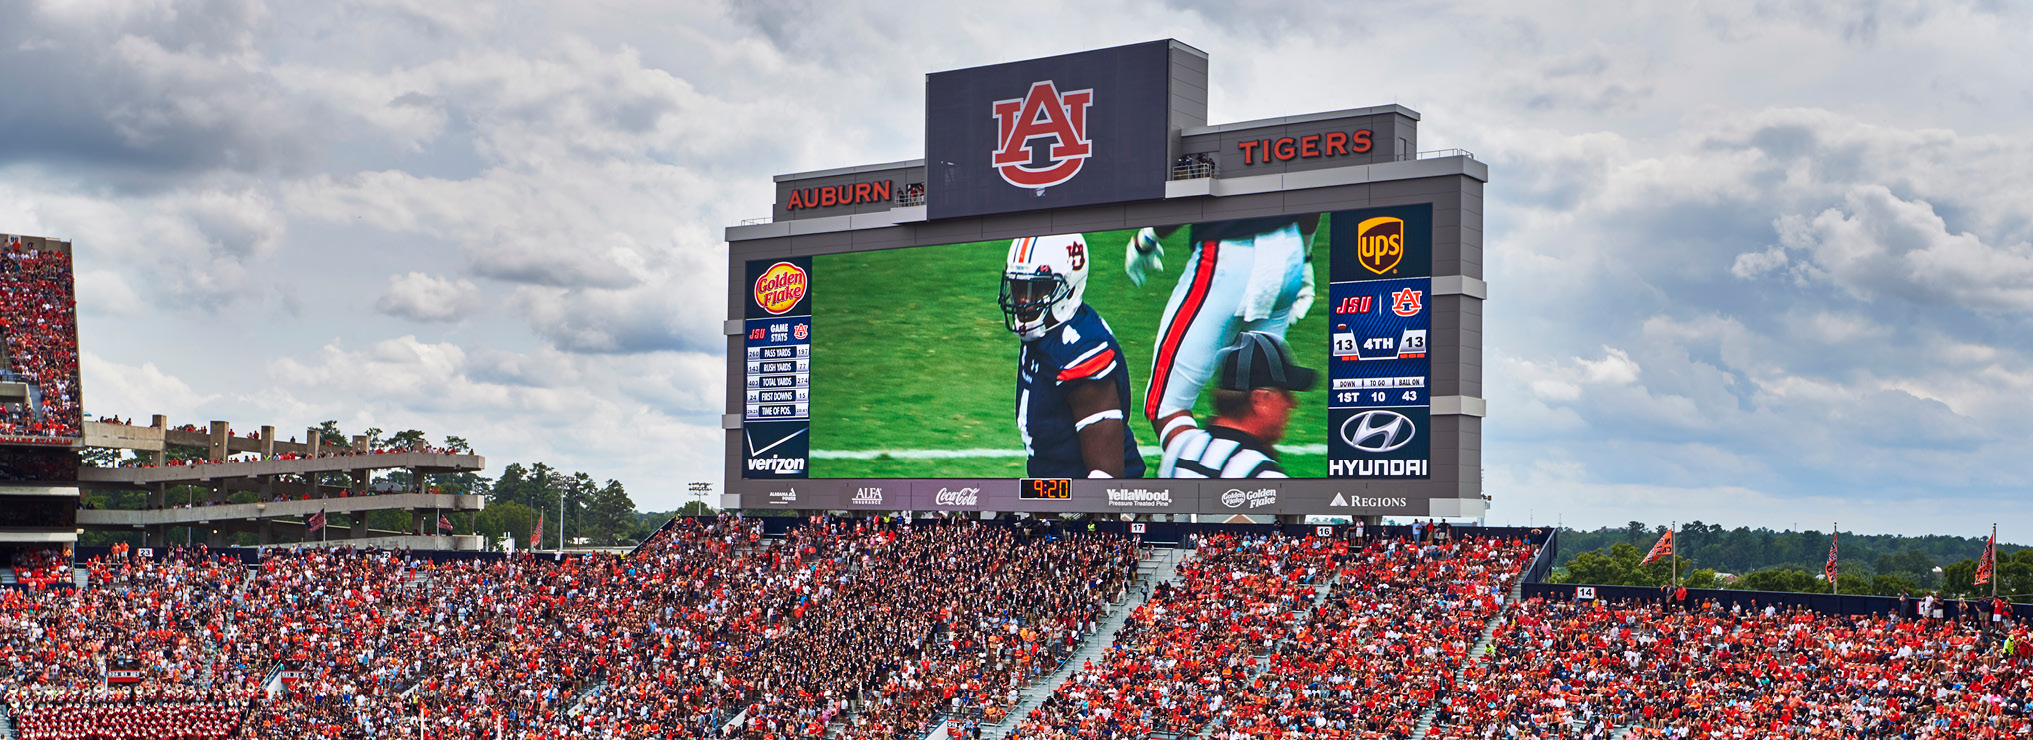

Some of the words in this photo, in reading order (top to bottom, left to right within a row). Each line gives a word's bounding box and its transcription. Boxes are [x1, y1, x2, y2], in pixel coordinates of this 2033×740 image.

[1239, 130, 1372, 164] TIGERS
[787, 181, 890, 210] AUBURN
[1361, 234, 1400, 265] ups
[758, 272, 803, 293] Golden
[764, 286, 801, 307] Flake
[1336, 296, 1372, 314] JSU
[770, 324, 788, 333] GAME
[749, 329, 765, 339] JSU
[771, 333, 788, 343] STATS
[1336, 340, 1353, 350] 13
[1363, 338, 1394, 350] 4TH
[1406, 337, 1424, 347] 13
[765, 349, 776, 358] PASS
[777, 348, 791, 357] YARDS
[776, 363, 791, 372] YARDS
[762, 378, 776, 387] TOTAL
[777, 377, 792, 386] YARDS
[762, 393, 773, 401] FIRST
[774, 392, 792, 401] DOWNS
[1337, 392, 1360, 403] 1ST
[1371, 392, 1386, 402] 10
[1402, 391, 1417, 401] 43
[773, 407, 780, 415] OF
[748, 454, 804, 474] verizon
[1329, 459, 1427, 476] HYUNDAI
[856, 487, 882, 499] ALFA
[1034, 480, 1068, 498] 9:20
[1246, 489, 1276, 500] Golden
[936, 487, 980, 505] Coca-Cola
[1249, 497, 1276, 508] Flake
[1580, 588, 1592, 596] 14
